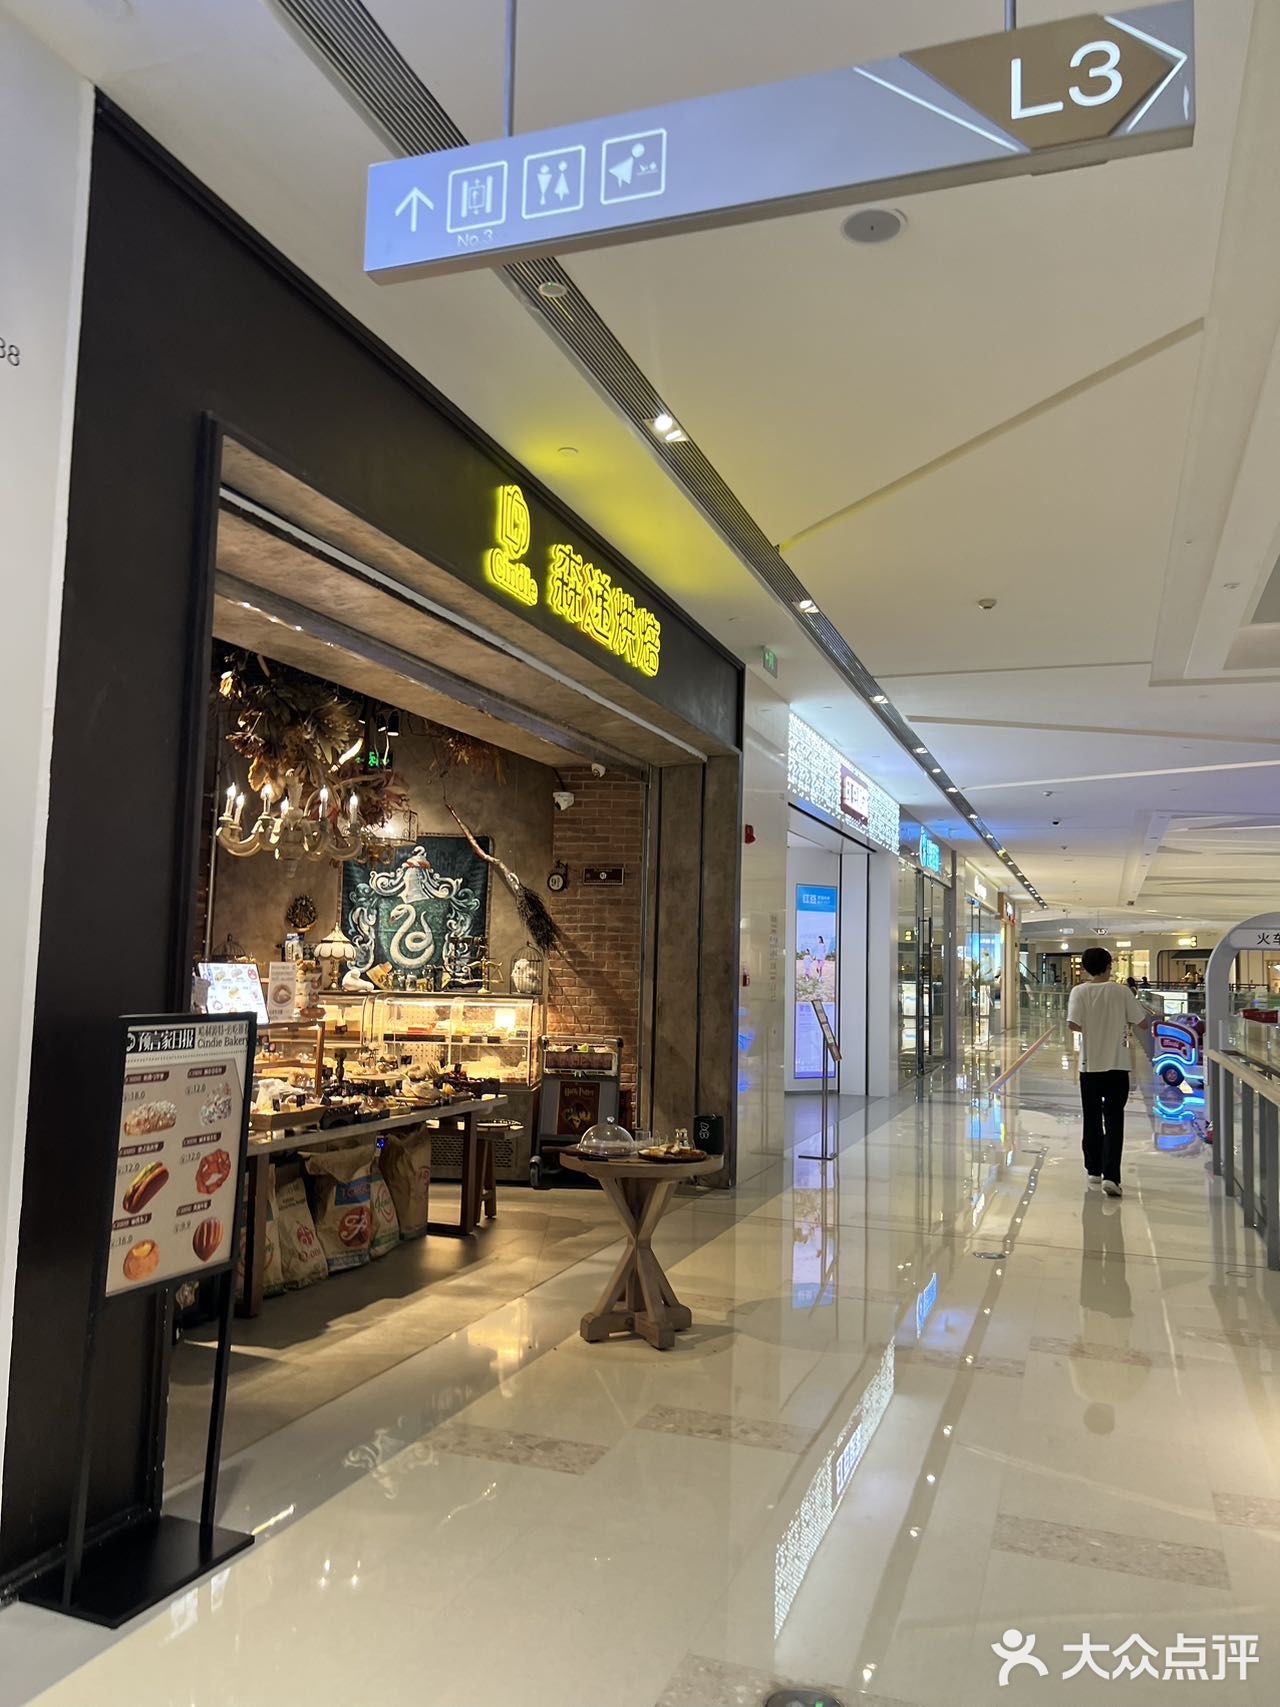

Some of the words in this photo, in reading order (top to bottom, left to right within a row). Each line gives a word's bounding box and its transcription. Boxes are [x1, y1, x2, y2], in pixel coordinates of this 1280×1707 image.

[1011, 40, 1123, 120] L3
[489, 548, 538, 606] Cindie
[138, 1028, 195, 1052] 预言家日报
